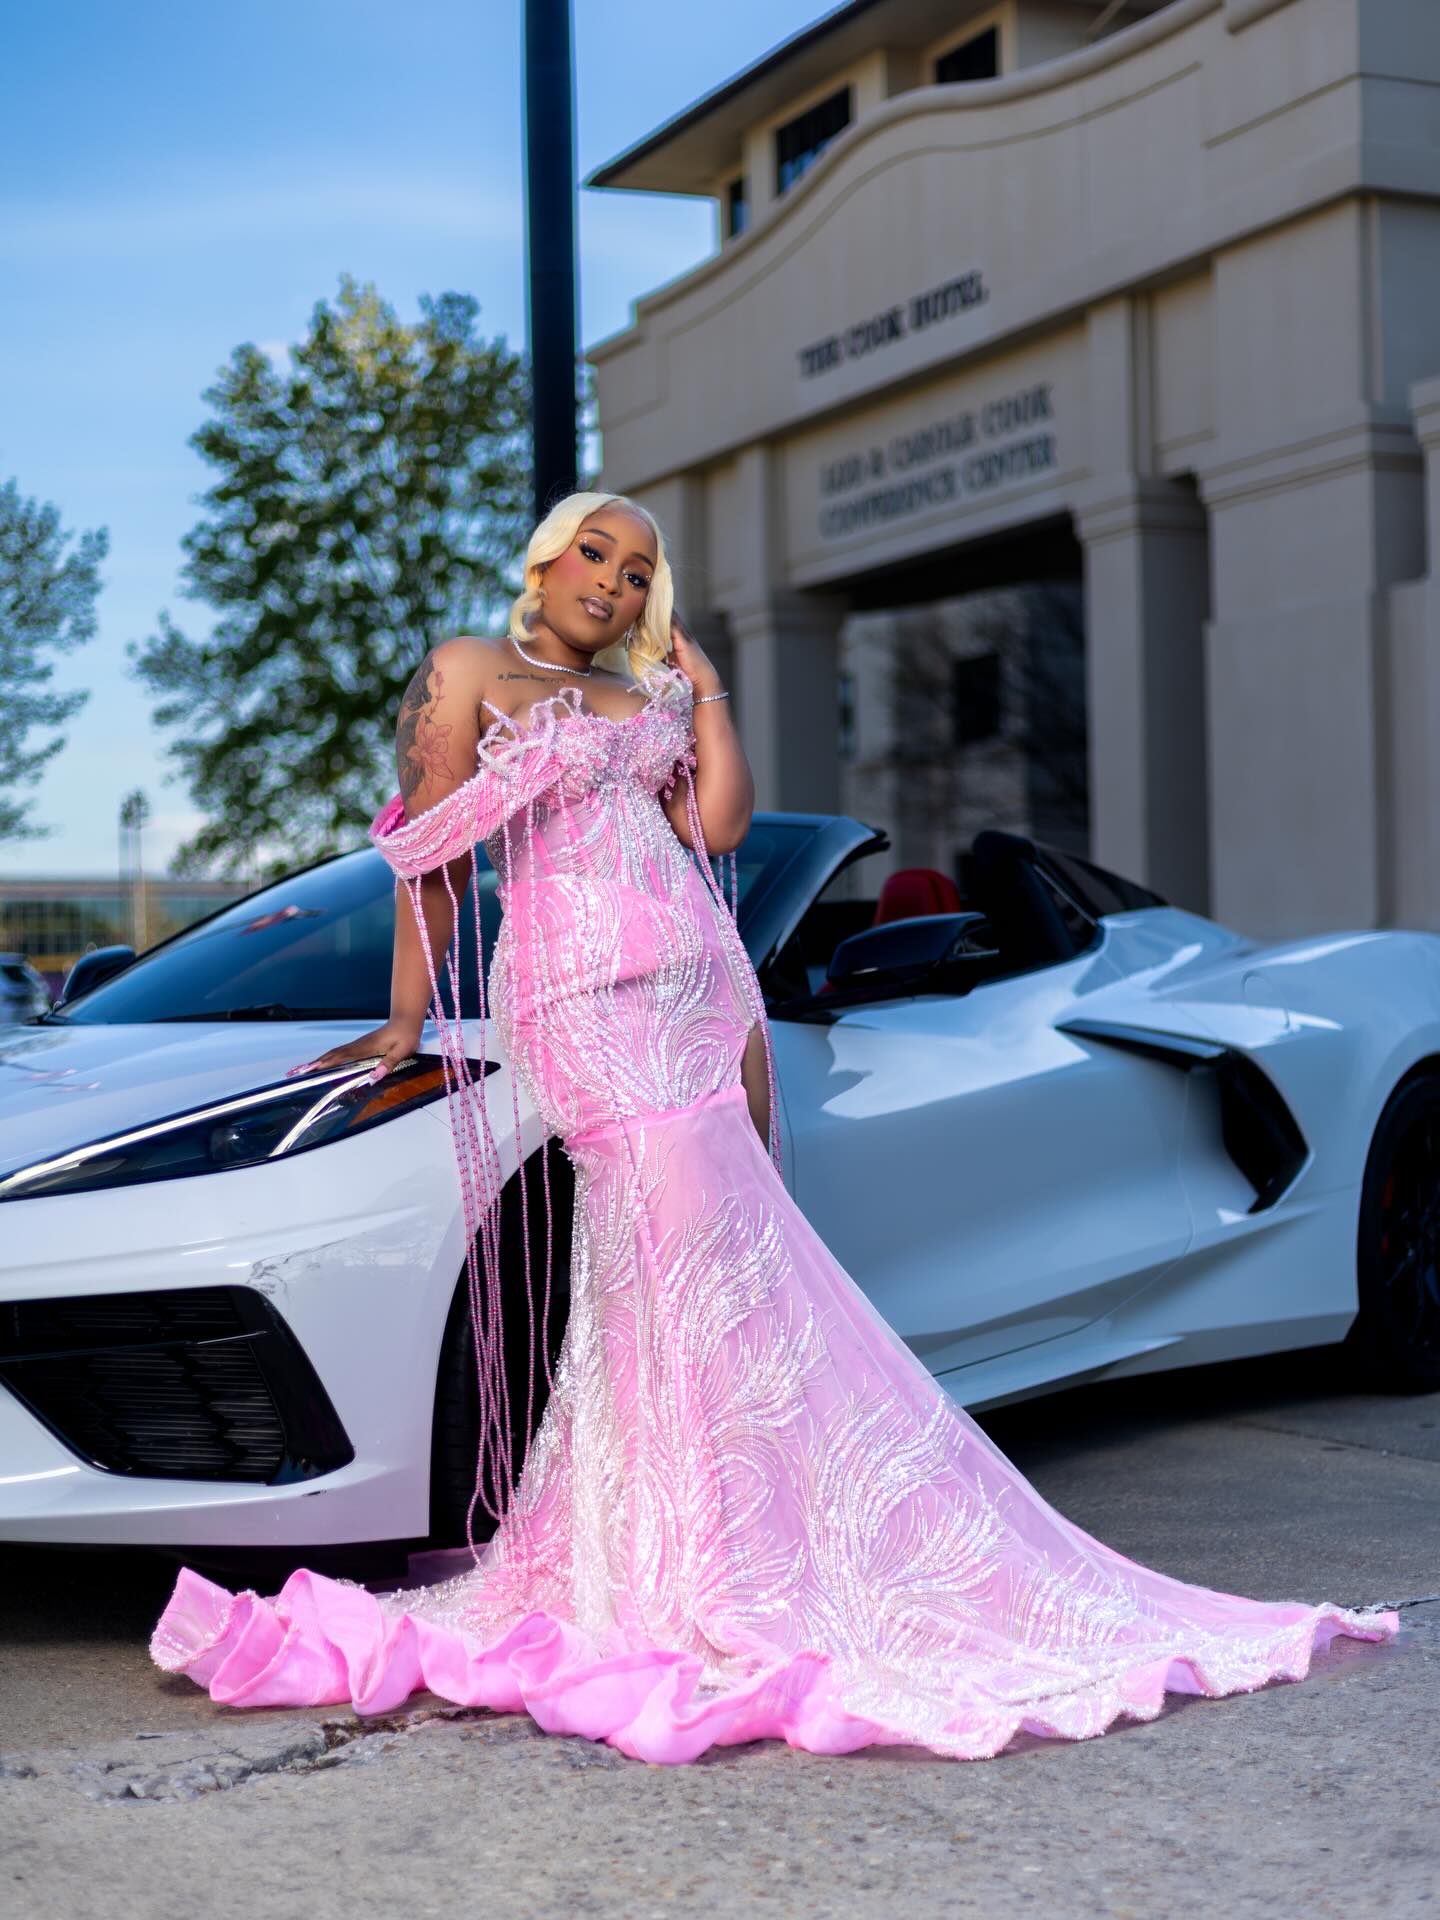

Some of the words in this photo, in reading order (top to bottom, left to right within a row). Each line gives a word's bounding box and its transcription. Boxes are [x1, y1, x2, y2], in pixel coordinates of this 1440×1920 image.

[799, 335, 843, 379] THE
[846, 305, 907, 359] COOK
[909, 270, 990, 332] HOTEL
[982, 380, 1057, 438] COOK
[818, 464, 957, 539] CONFERENCE
[962, 431, 1059, 493] CENTER
